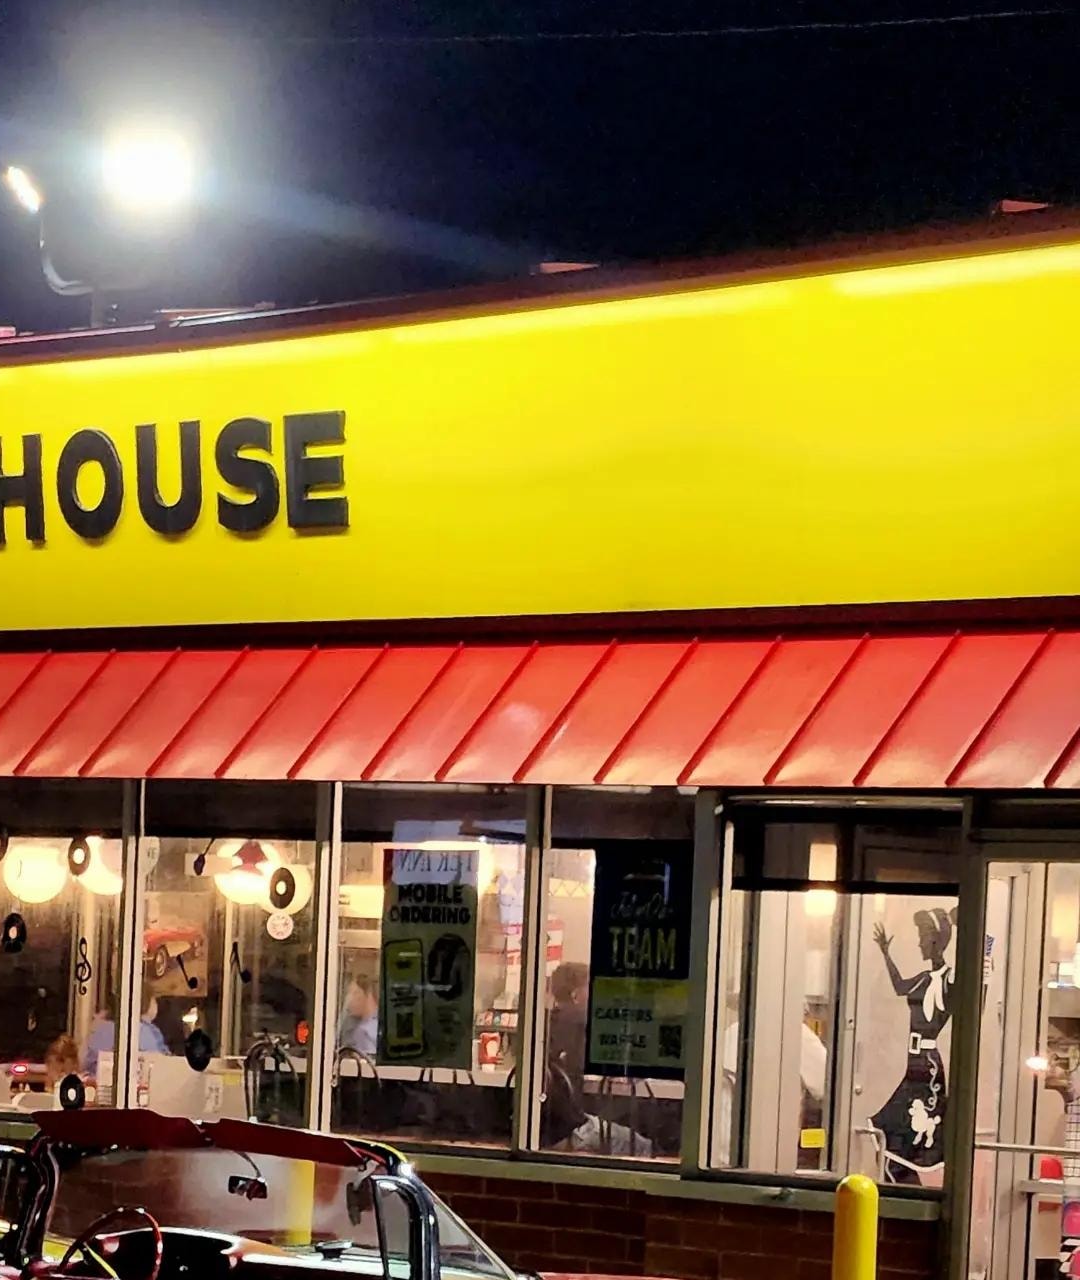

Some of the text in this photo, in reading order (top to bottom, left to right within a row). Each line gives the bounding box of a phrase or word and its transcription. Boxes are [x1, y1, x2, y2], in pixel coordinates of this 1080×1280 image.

[398, 883, 463, 904] MOBILE
[390, 905, 471, 924] ORDERING
[608, 926, 677, 971] TEAM
